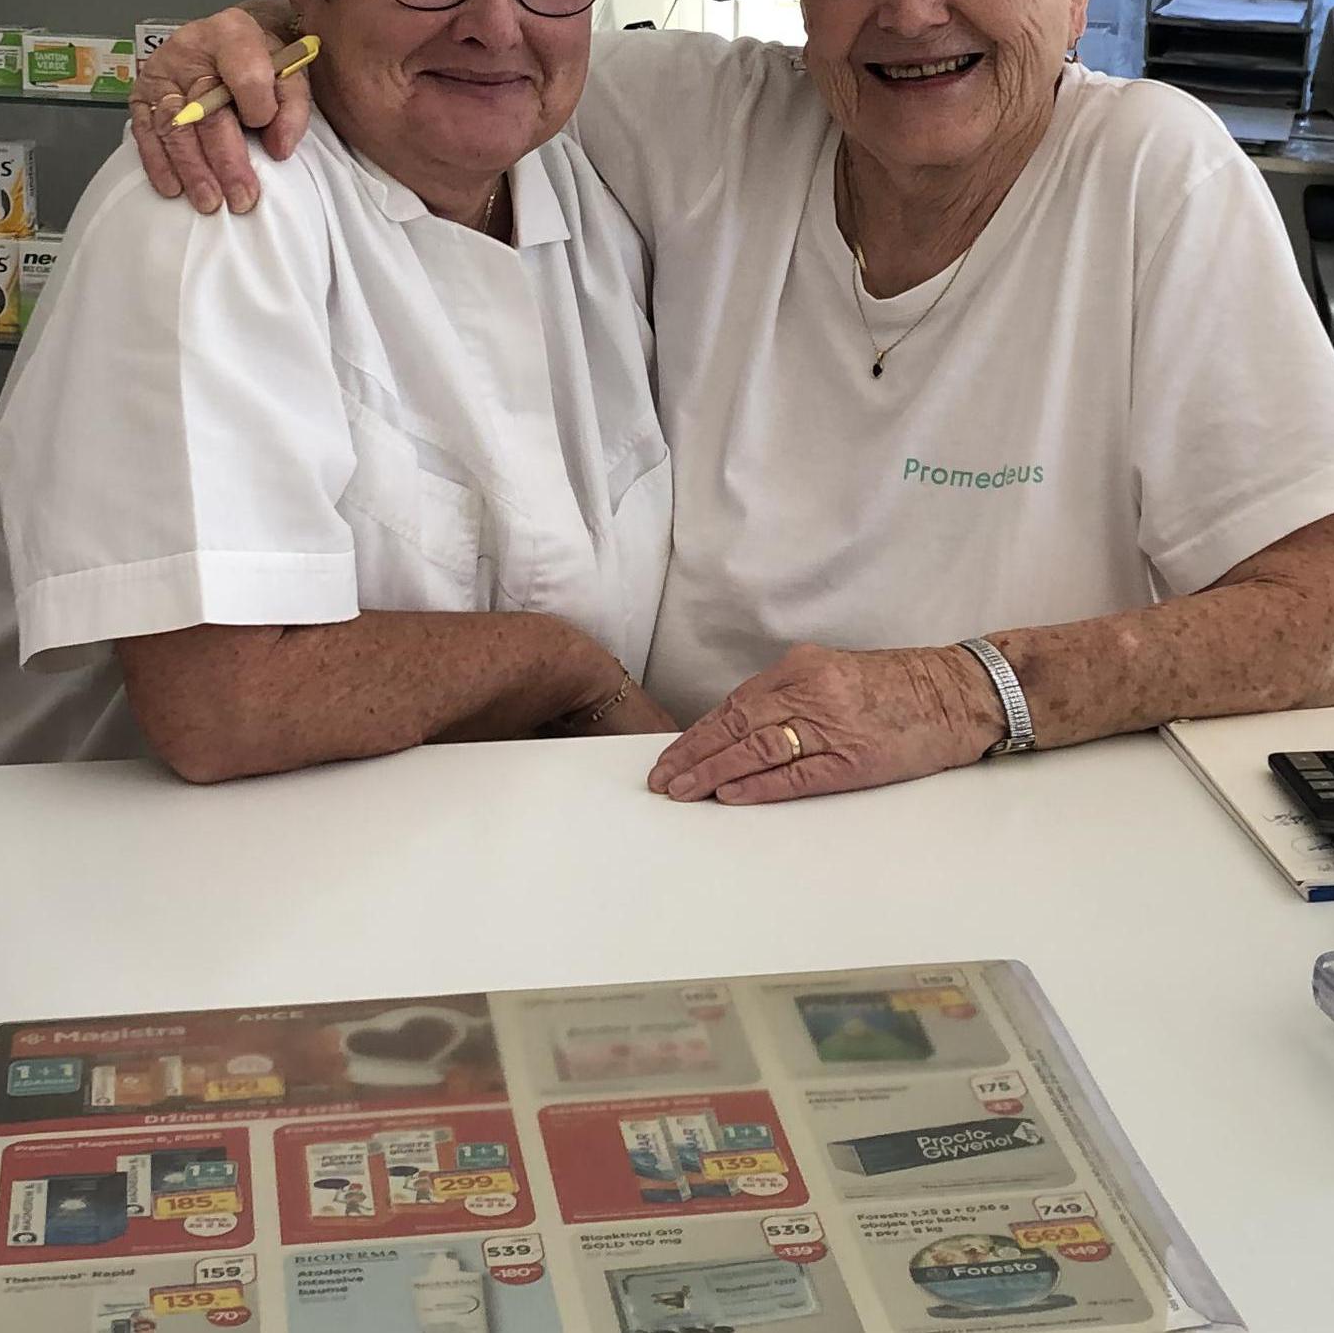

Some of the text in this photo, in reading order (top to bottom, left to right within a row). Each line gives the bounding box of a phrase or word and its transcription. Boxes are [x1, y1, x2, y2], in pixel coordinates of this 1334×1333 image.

[903, 458, 1045, 489] Promedeus
[53, 1026, 186, 1044] Magistra
[921, 1134, 1015, 1160] Glyvenol
[1038, 1203, 1082, 1215] 749
[766, 1224, 811, 1237] 539
[1023, 1228, 1080, 1243] 669
[630, 1238, 655, 1248] 100
[486, 1244, 531, 1258] 539
[200, 1266, 242, 1279] 159
[952, 1261, 1038, 1278] Foresto
